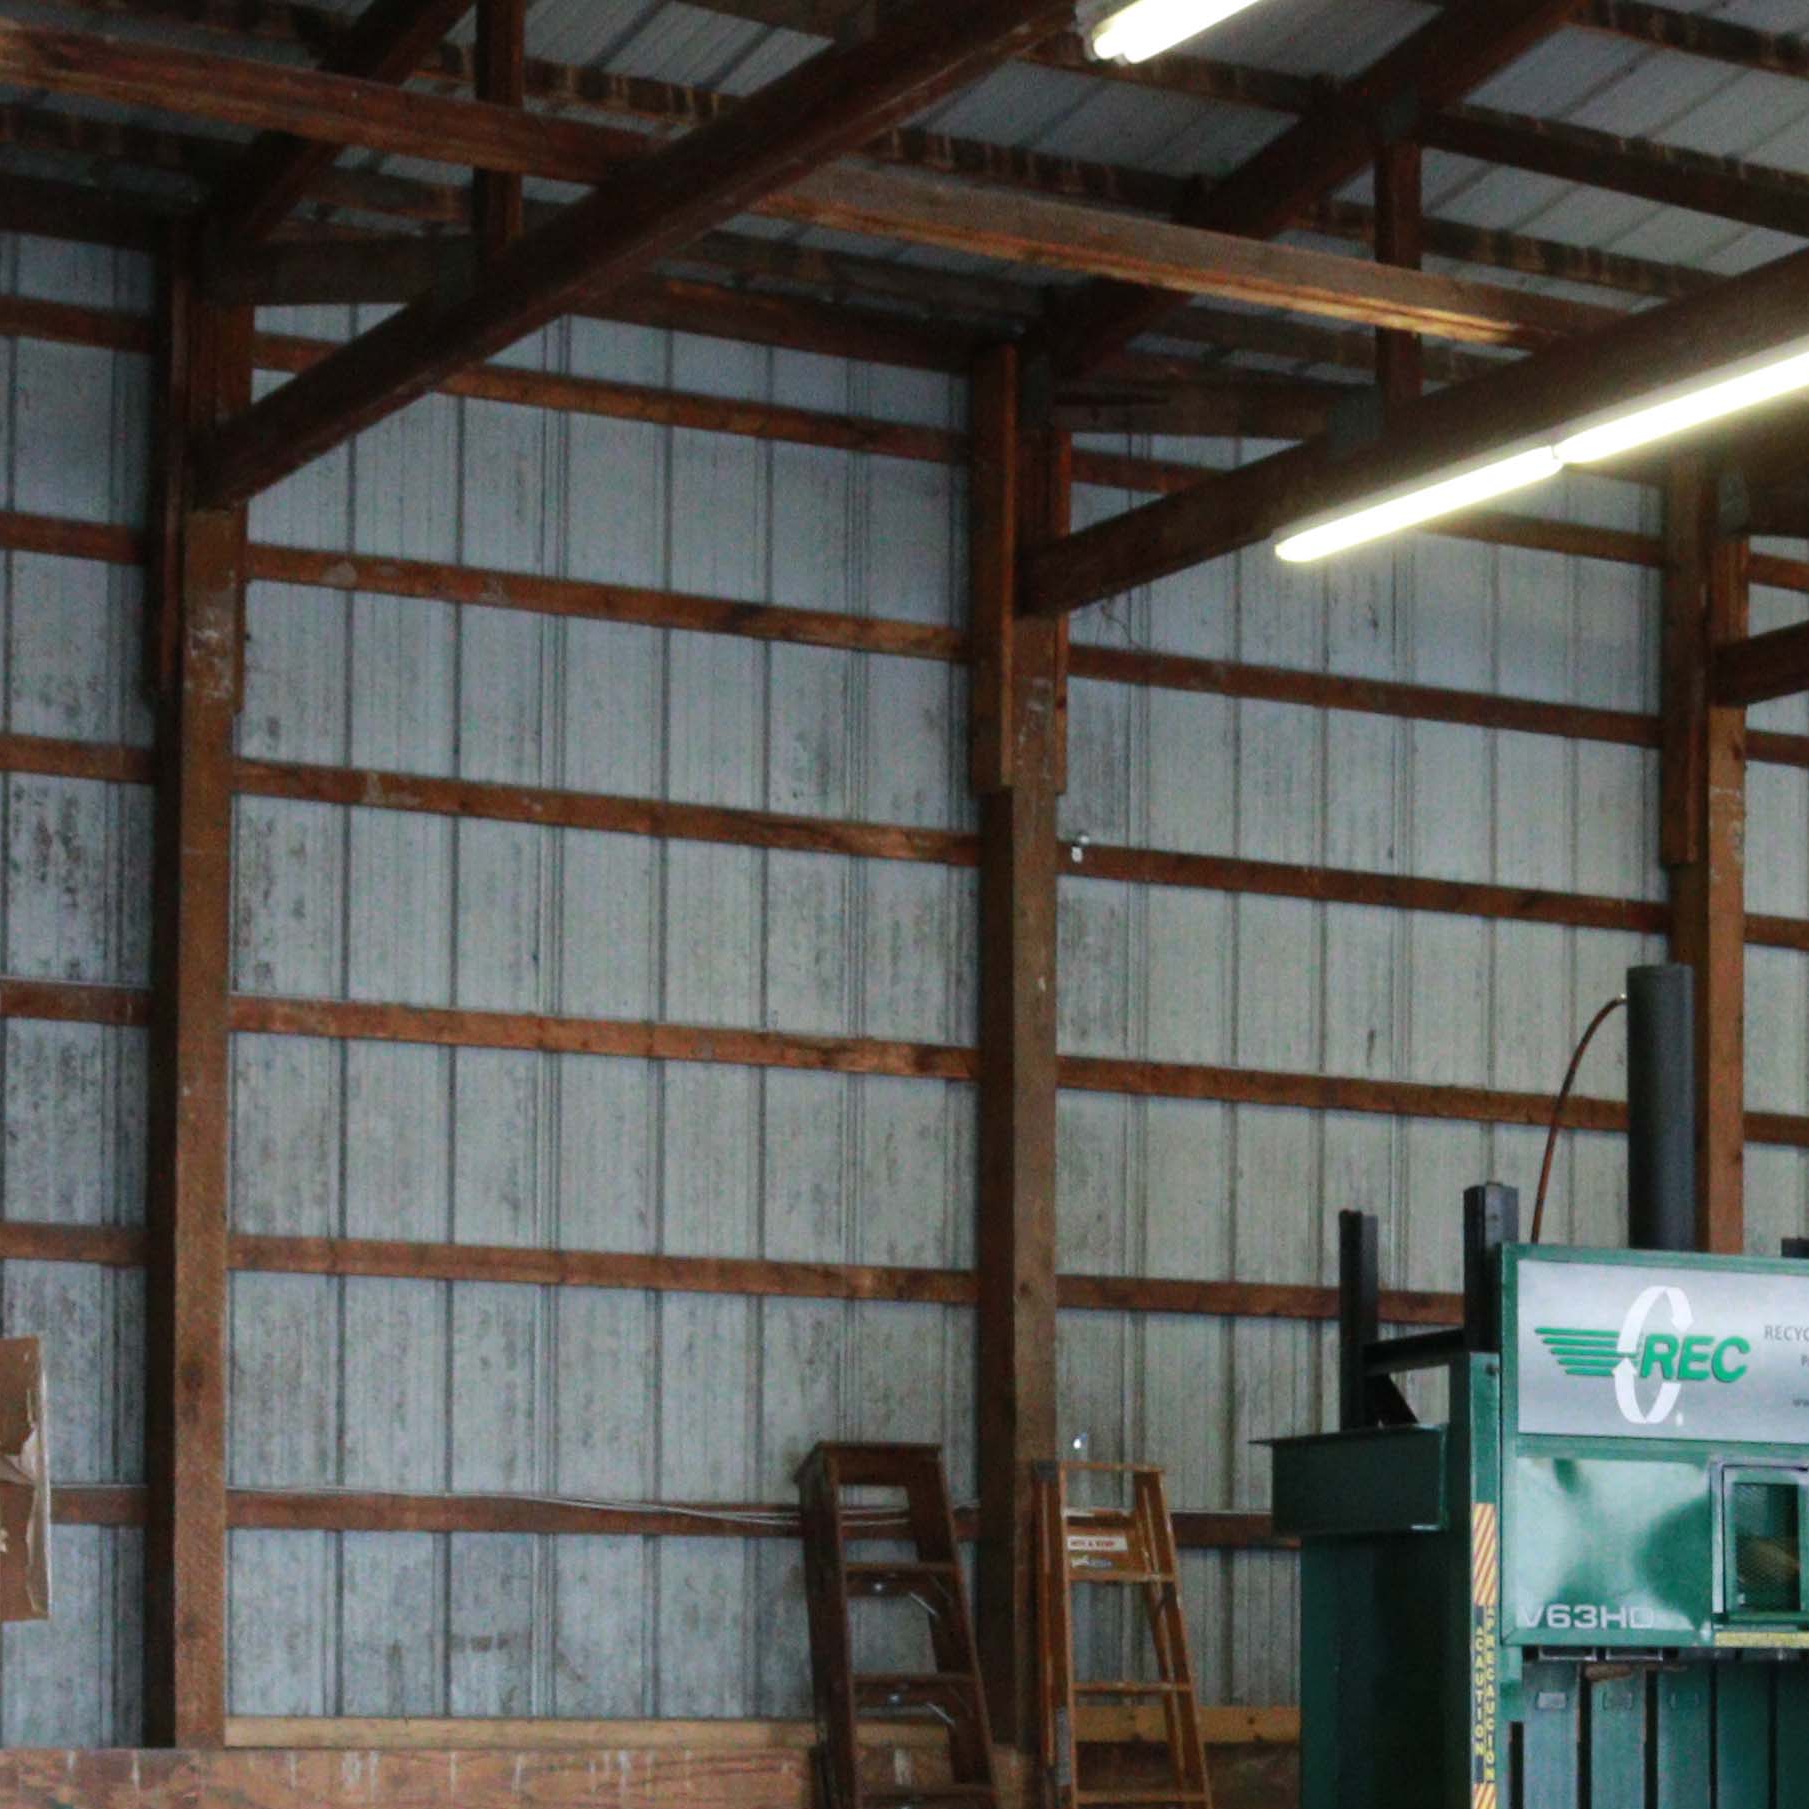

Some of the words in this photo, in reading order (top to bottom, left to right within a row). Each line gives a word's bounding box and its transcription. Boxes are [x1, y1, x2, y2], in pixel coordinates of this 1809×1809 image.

[1640, 1333, 1752, 1384] REC
[1518, 1604, 1655, 1629] V63HD
[1475, 1637, 1485, 1756] CAUTION
